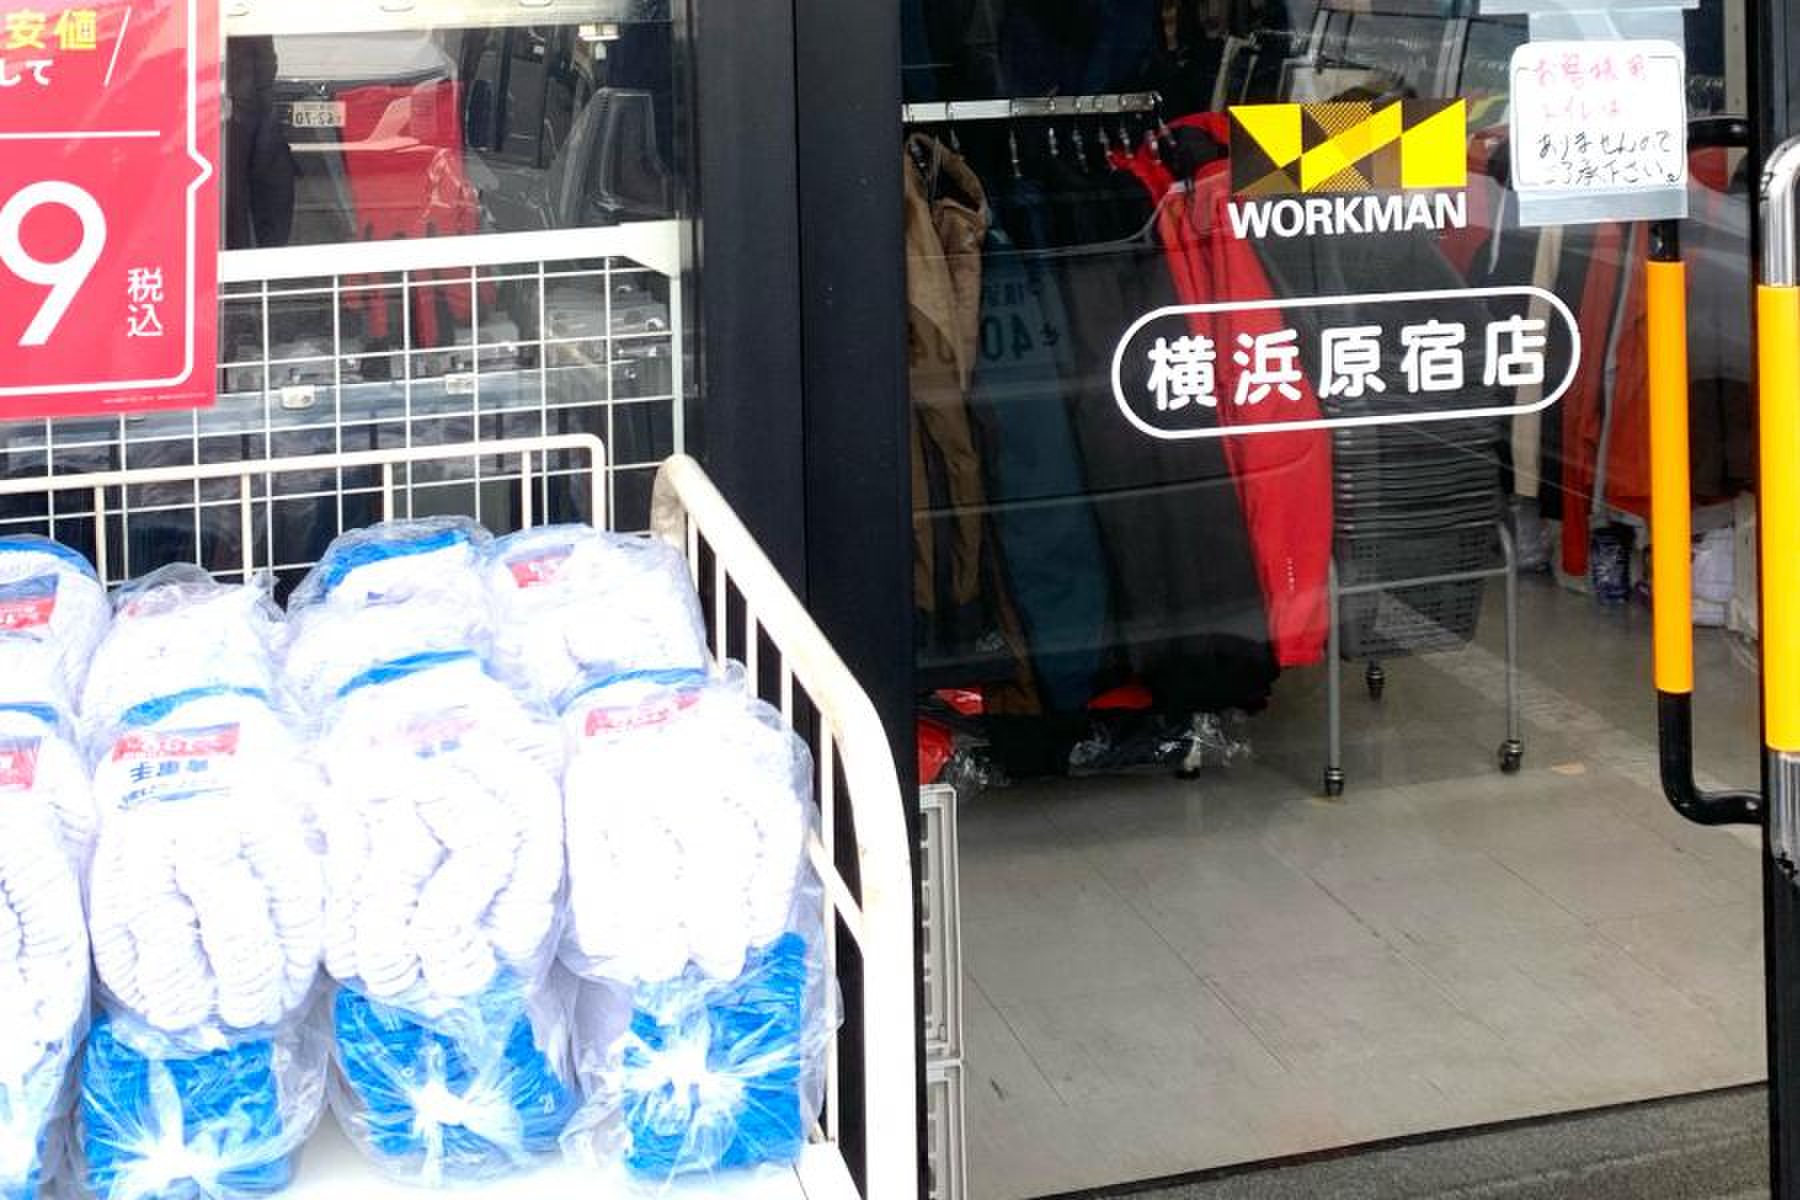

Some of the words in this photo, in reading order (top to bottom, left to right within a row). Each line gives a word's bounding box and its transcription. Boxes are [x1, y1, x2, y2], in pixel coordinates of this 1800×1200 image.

[6, 8, 97, 51] 安値
[1227, 192, 1468, 240] WORKMAN
[0, 181, 107, 346] 9
[128, 268, 164, 338] 税込
[1147, 314, 1548, 412] 横浜原宿店
